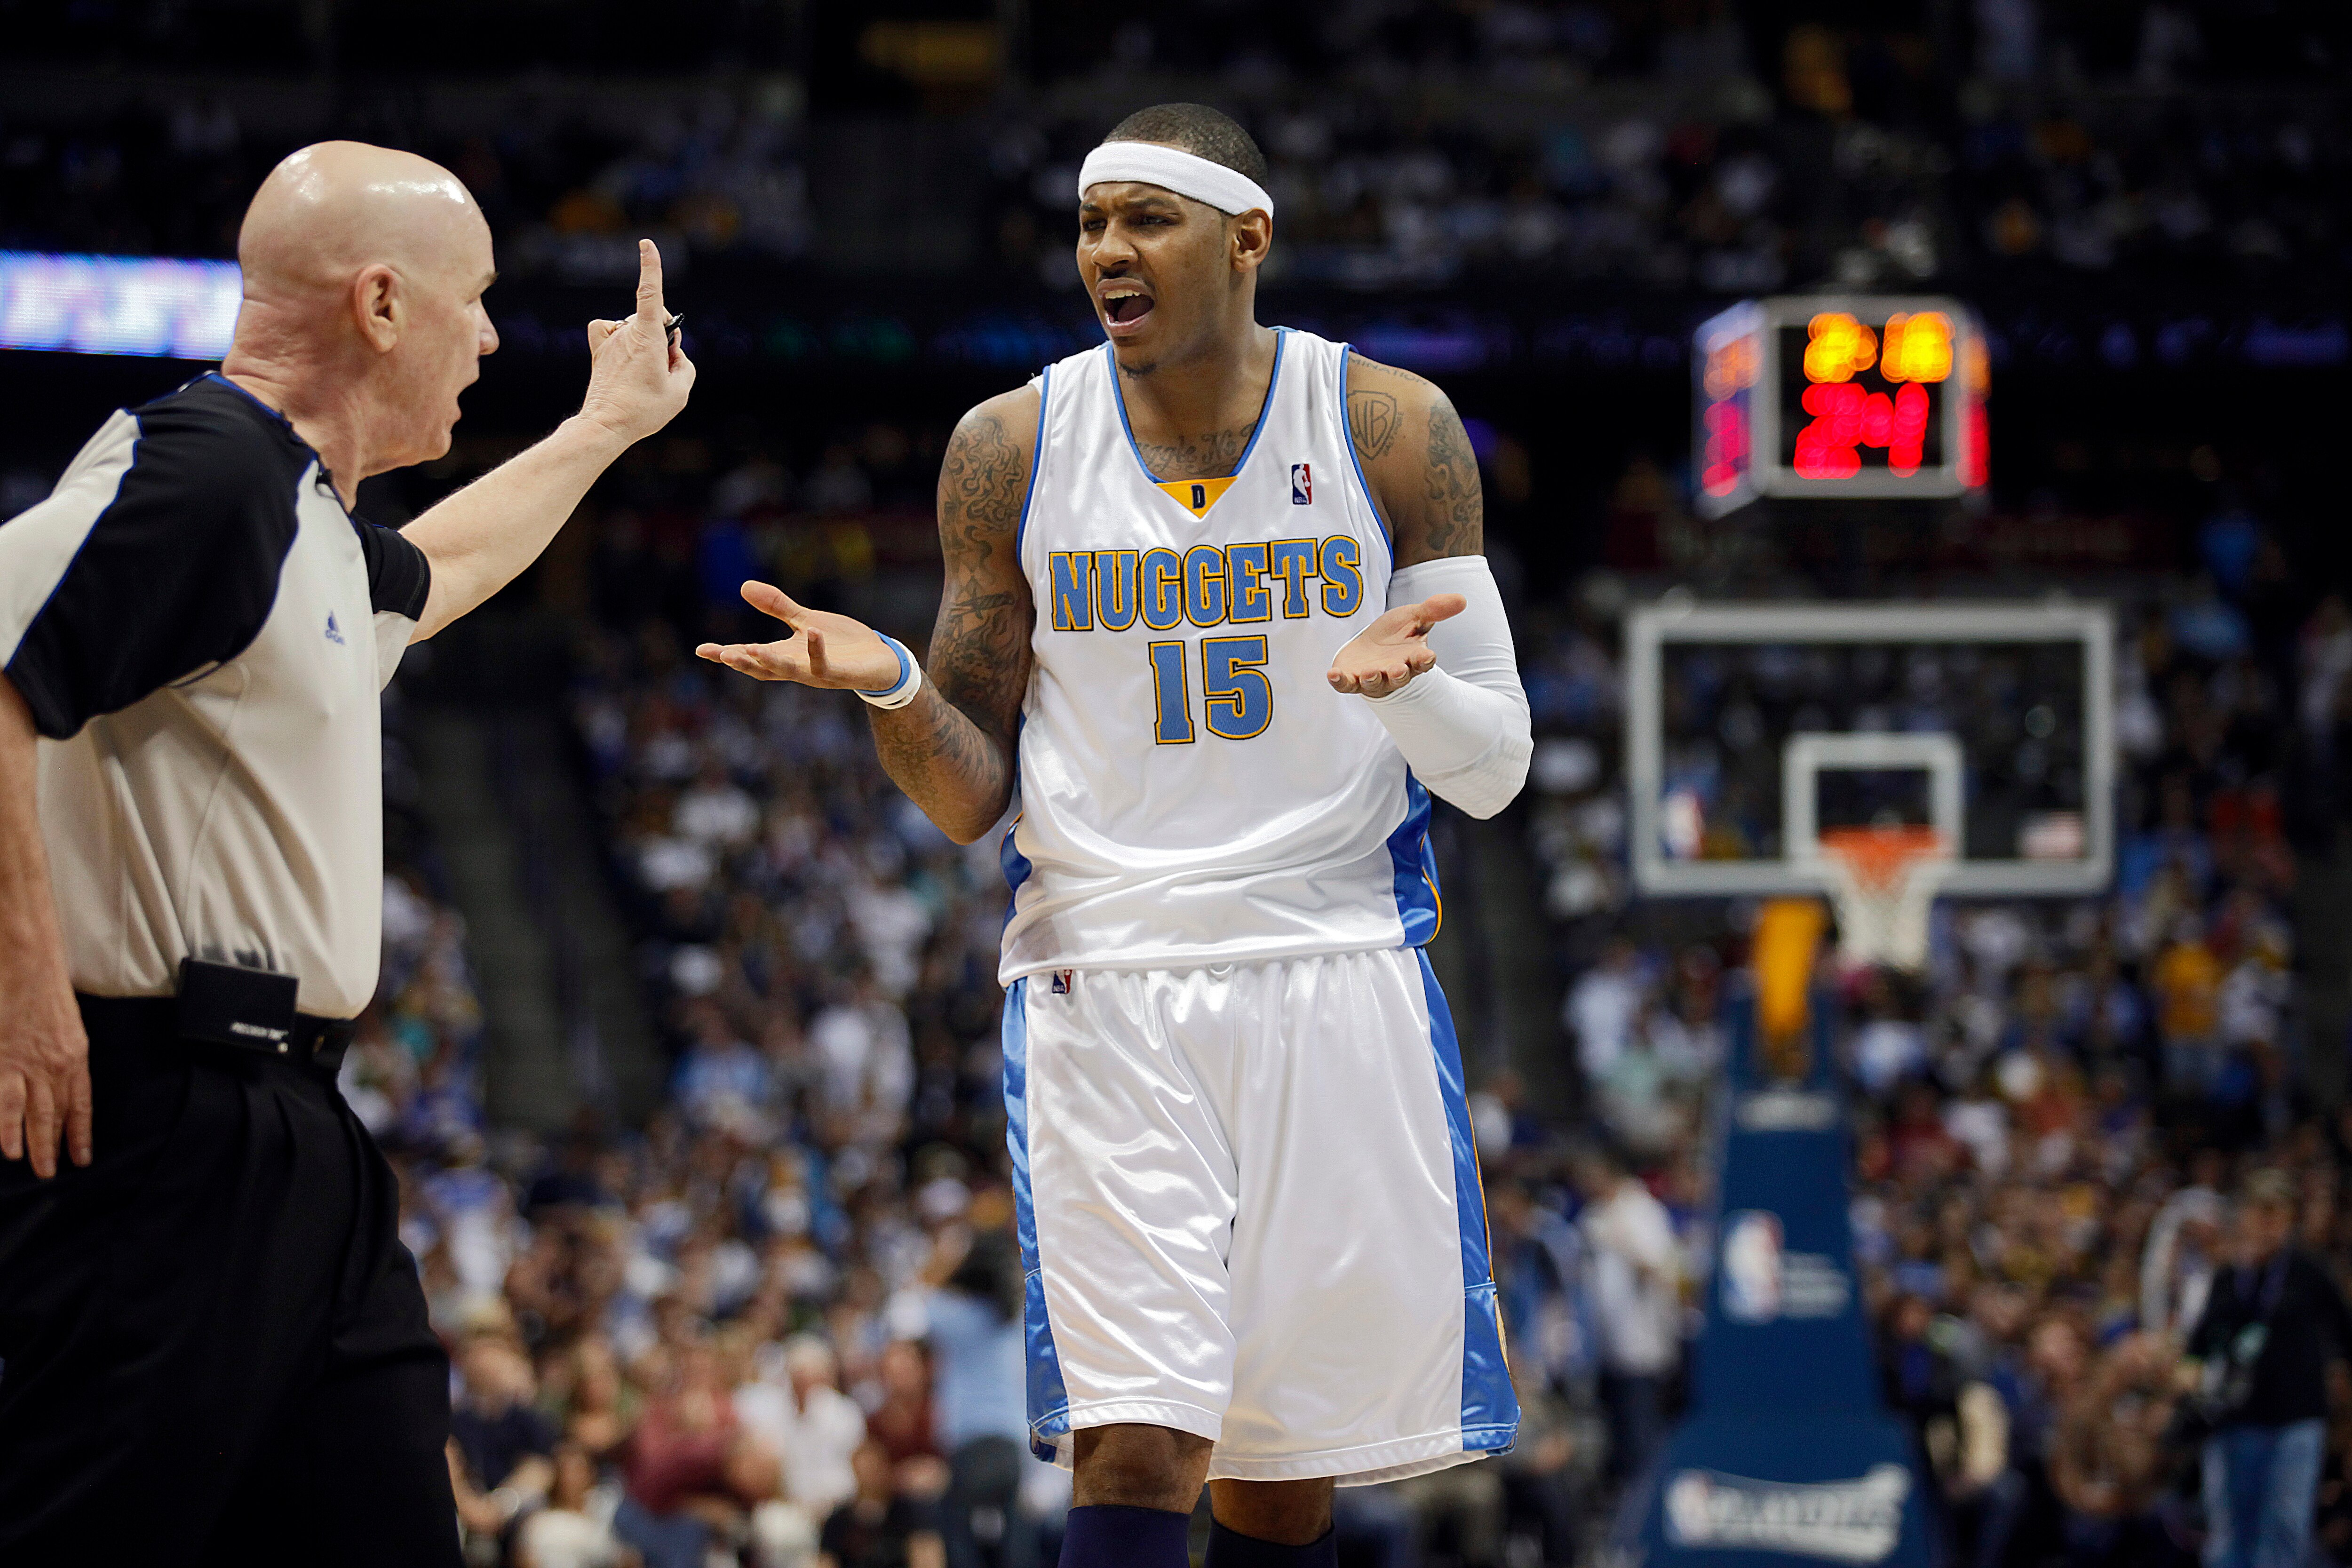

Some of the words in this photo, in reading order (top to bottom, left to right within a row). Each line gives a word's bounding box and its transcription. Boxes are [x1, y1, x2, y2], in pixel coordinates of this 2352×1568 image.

[1794, 382, 1929, 478] 24
[1191, 484, 1206, 509] D
[1049, 534, 1364, 631] NUGGETS
[1148, 635, 1273, 745] 15
